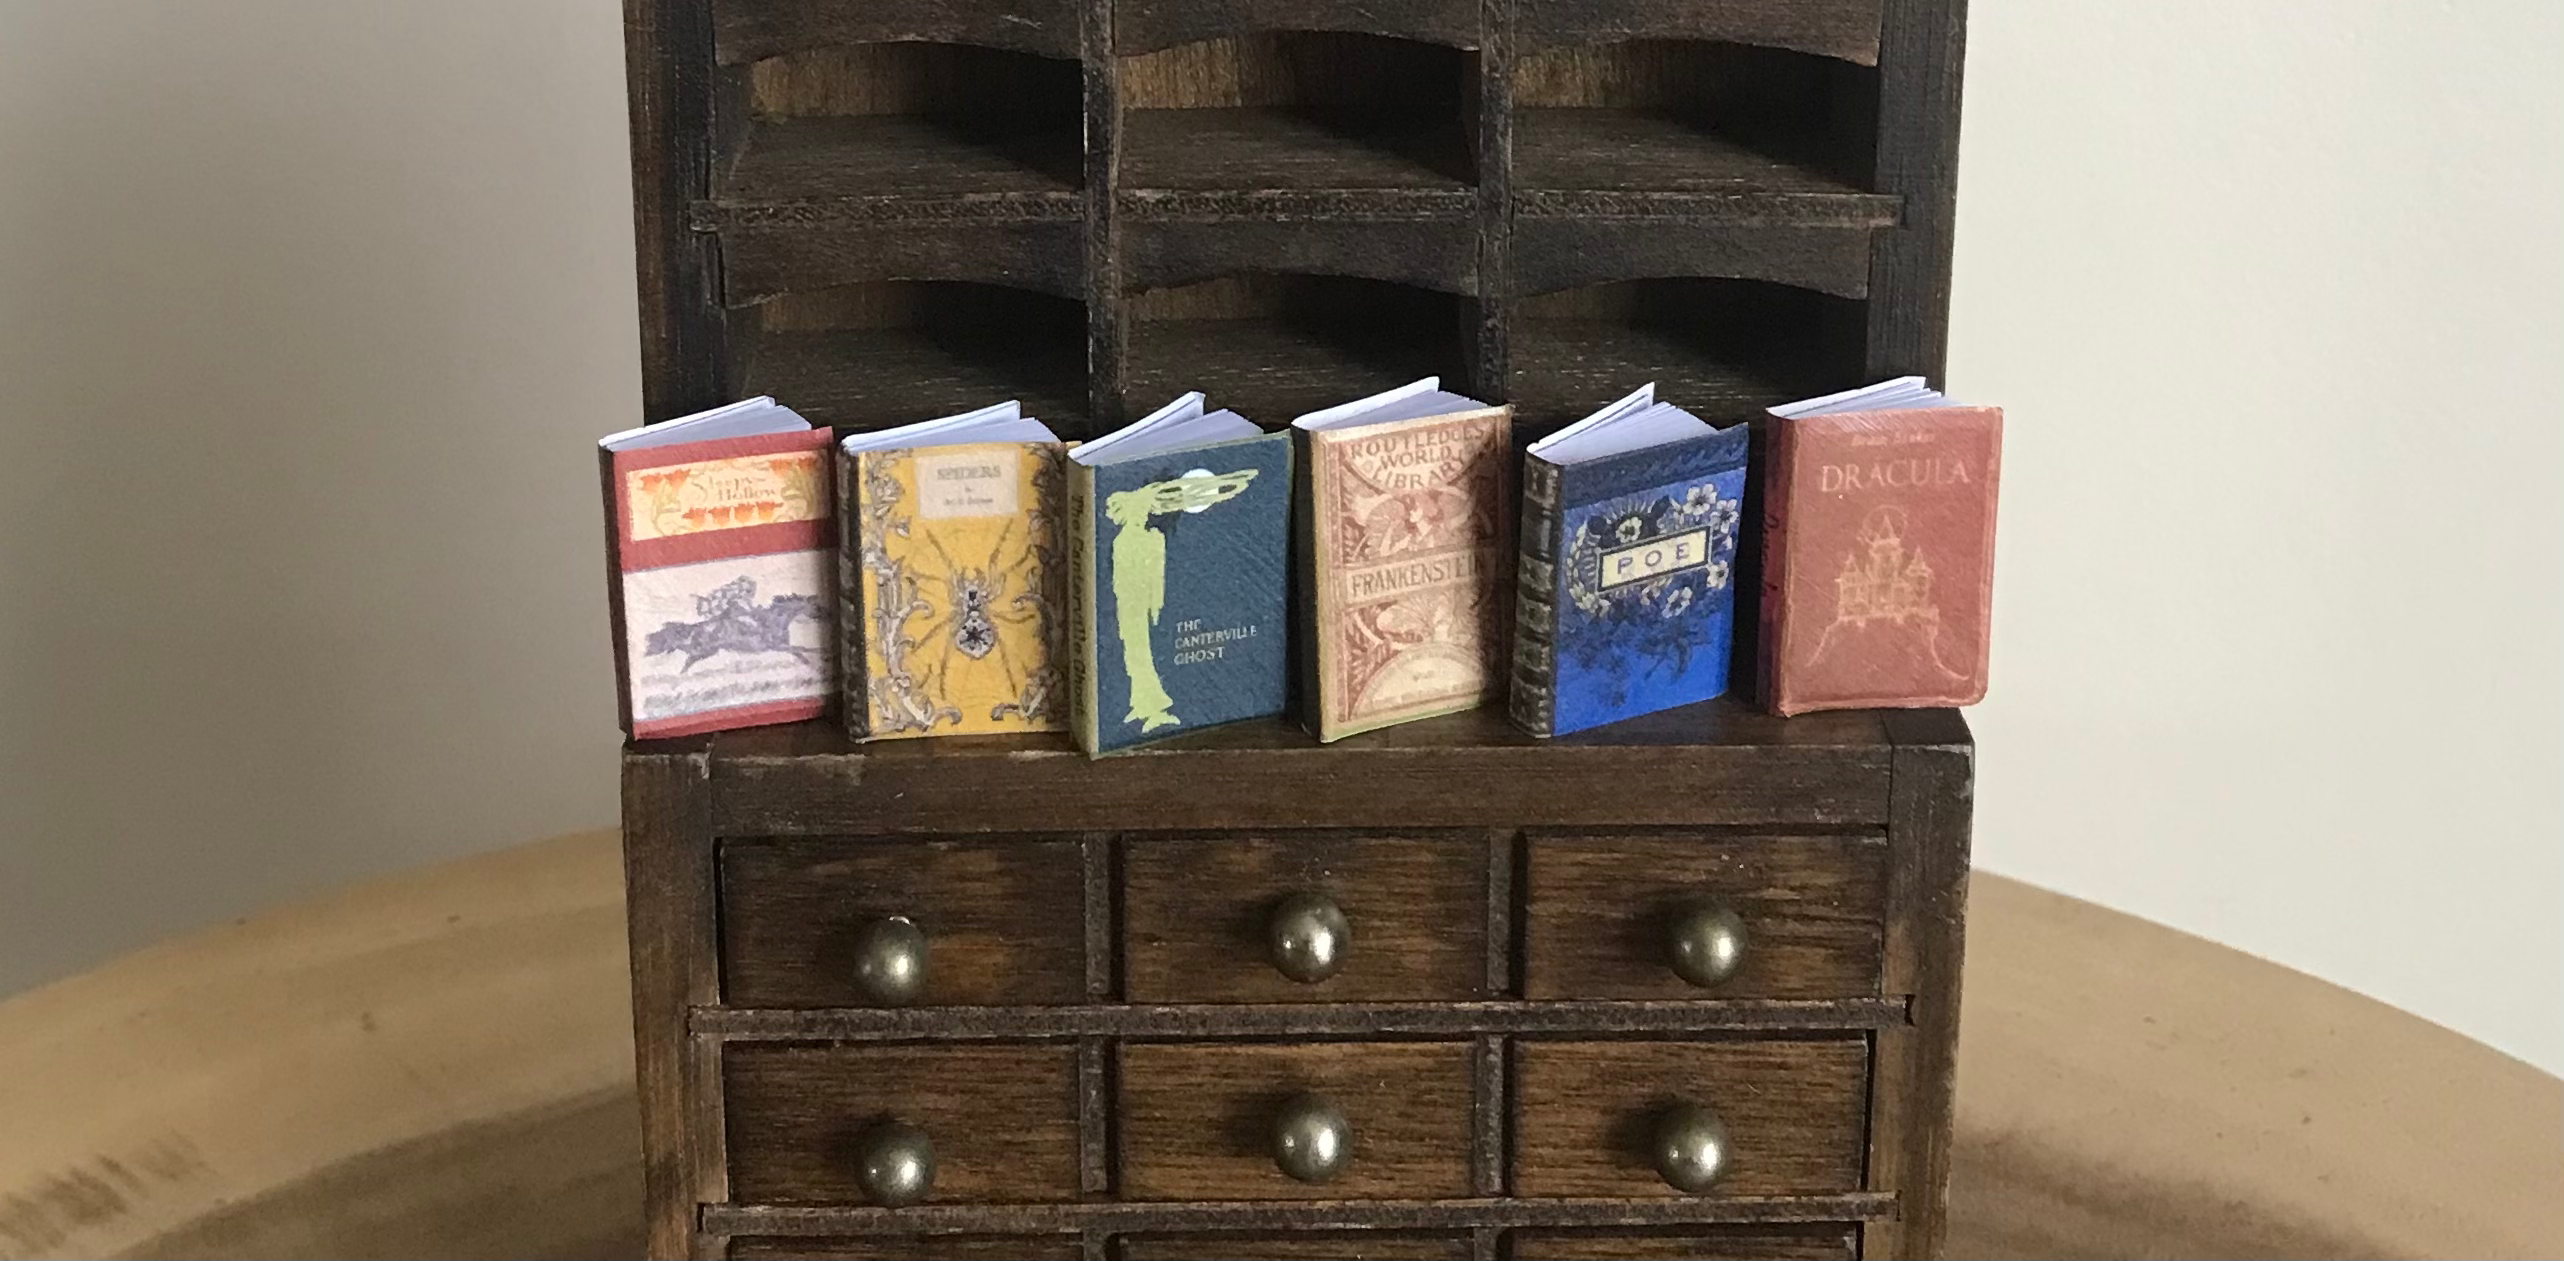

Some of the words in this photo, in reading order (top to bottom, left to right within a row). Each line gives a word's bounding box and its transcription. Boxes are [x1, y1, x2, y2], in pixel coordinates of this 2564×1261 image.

[1372, 448, 1464, 489] LIBRARY
[1380, 445, 1453, 470] WORLD
[1820, 457, 1971, 492] DRACULA
[717, 486, 776, 502] Hollow
[1617, 542, 1690, 575] POE
[1174, 624, 1258, 650] CANTERVILLE
[1173, 646, 1225, 666] GHOST
